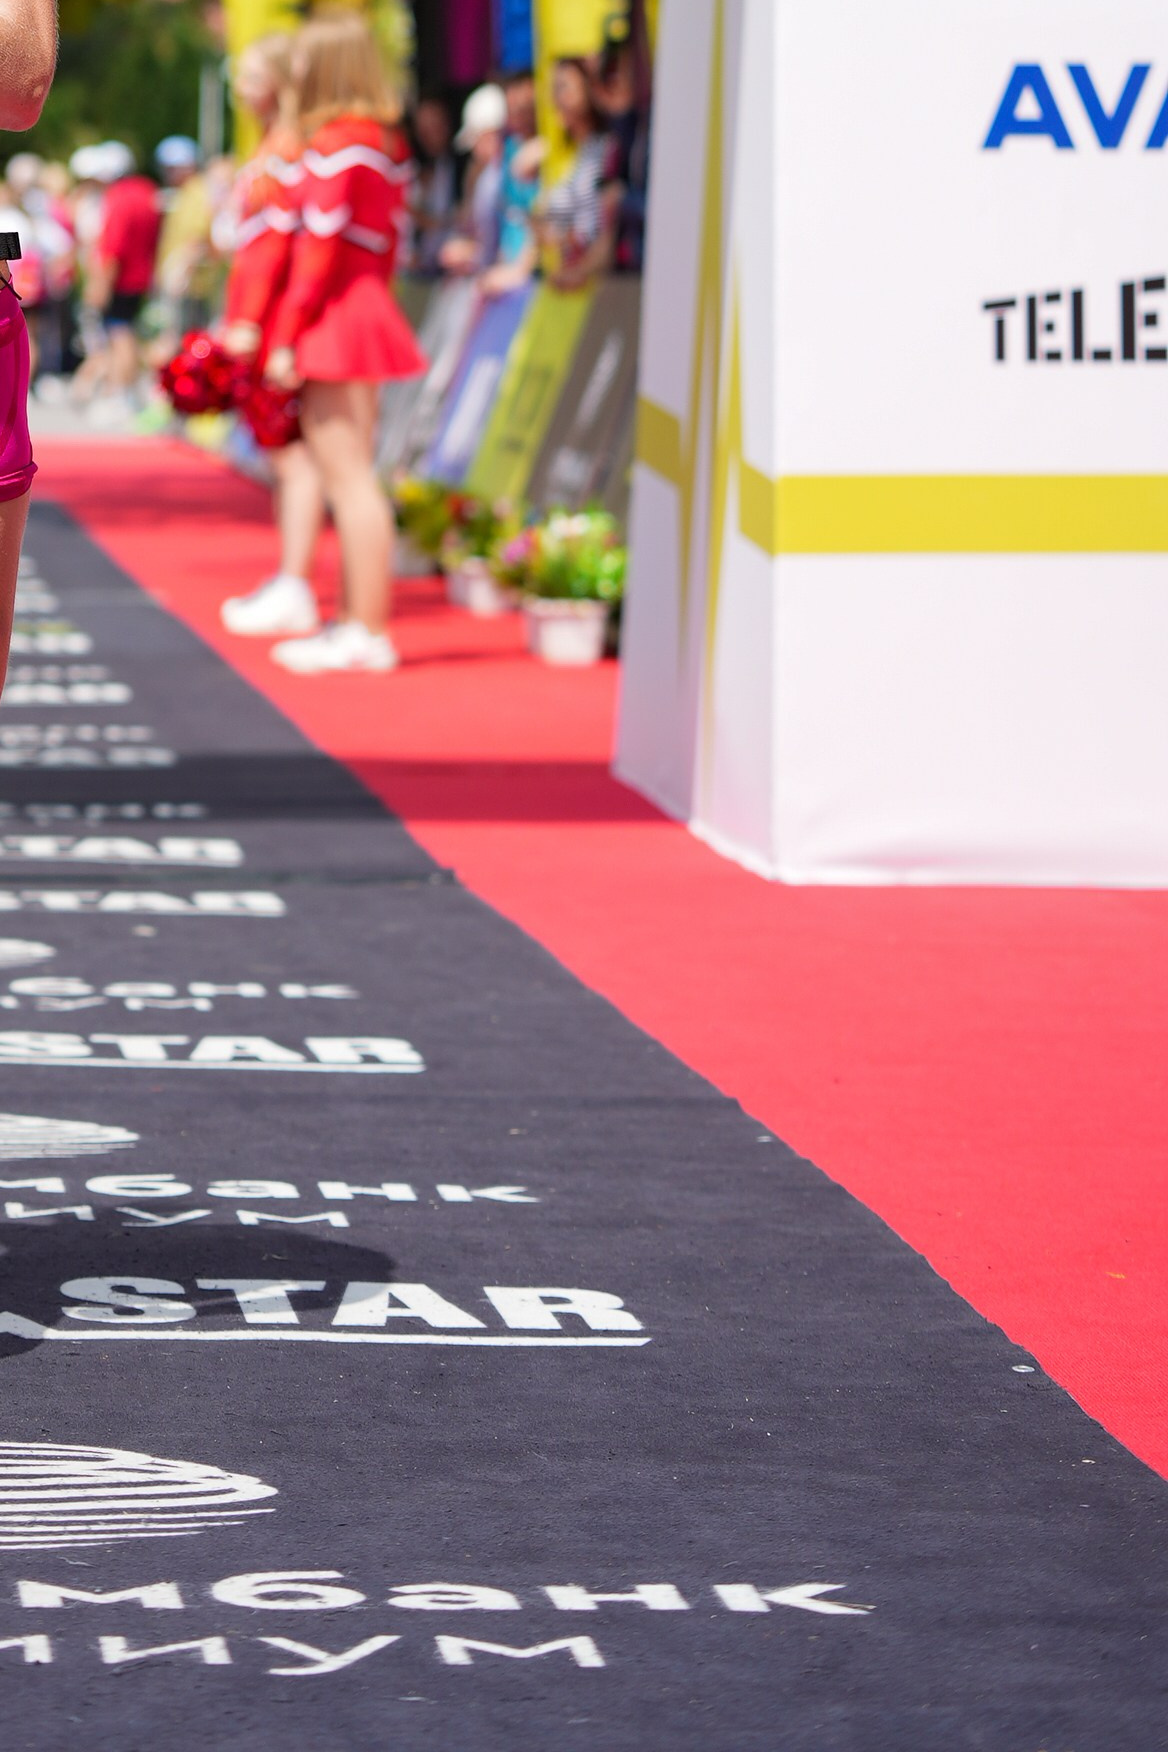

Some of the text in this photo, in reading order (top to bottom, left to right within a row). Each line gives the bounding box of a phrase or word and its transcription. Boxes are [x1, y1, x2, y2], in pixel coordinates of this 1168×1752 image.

[982, 63, 1168, 150] AV
[983, 275, 1168, 361] TELE
[61, 1277, 644, 1330] STAR
